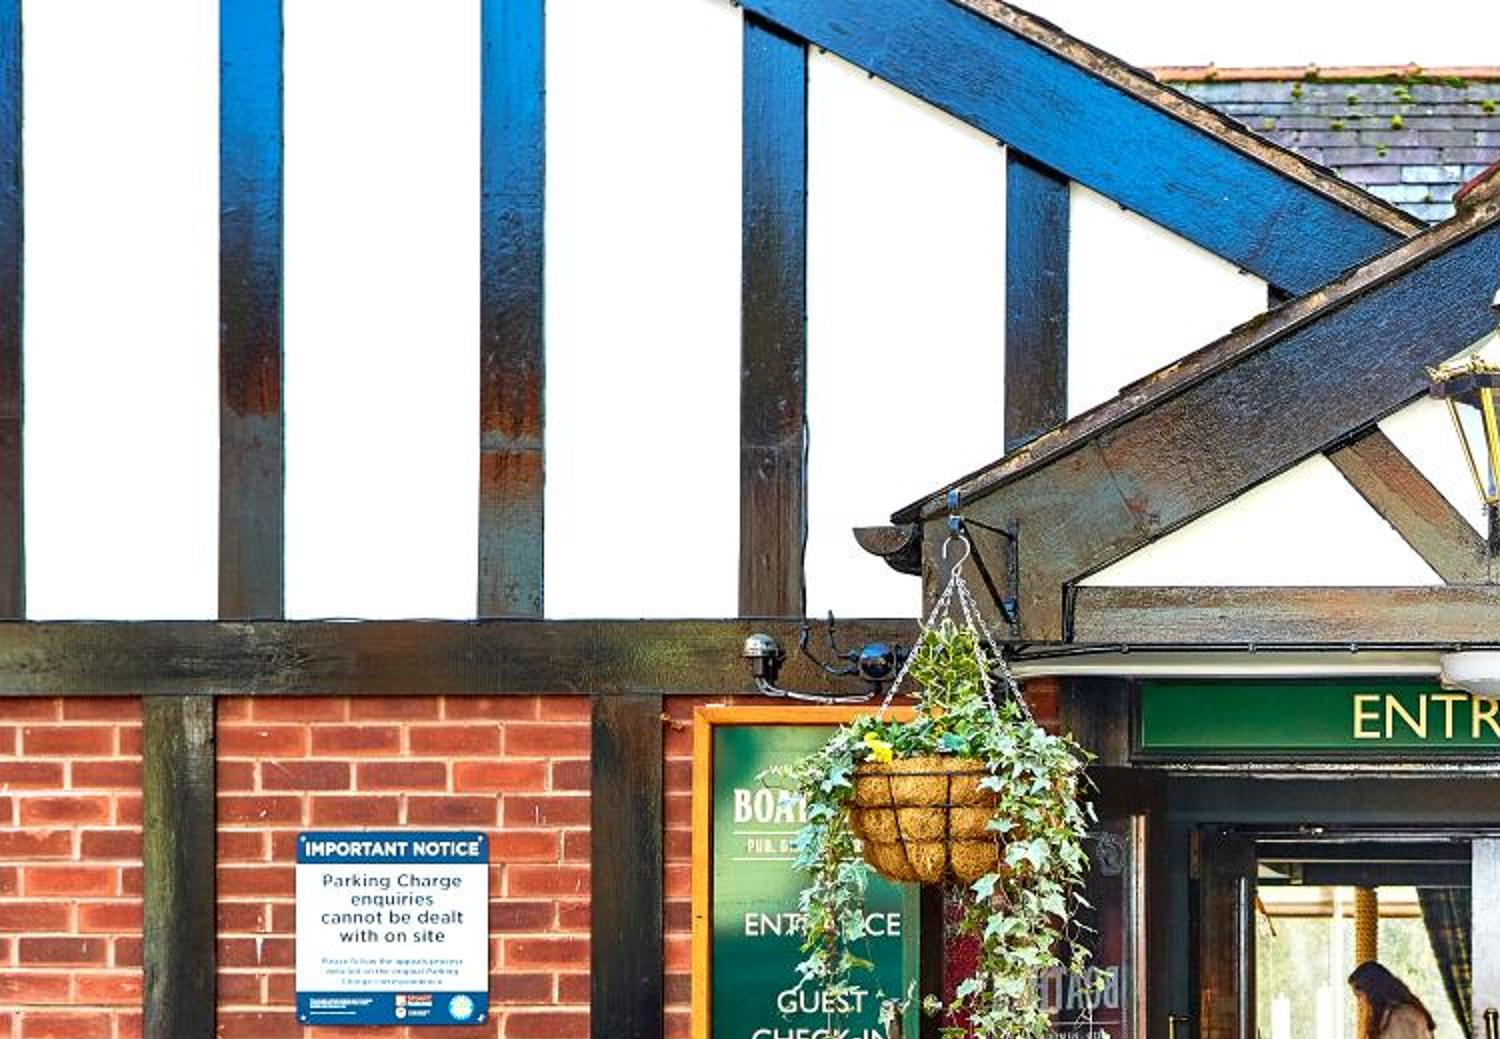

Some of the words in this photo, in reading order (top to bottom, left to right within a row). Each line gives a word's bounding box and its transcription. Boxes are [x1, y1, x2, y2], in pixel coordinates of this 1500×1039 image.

[305, 842, 408, 856] IMPORTANT
[413, 842, 480, 856] NOTICE
[323, 873, 391, 890] Parking
[397, 873, 463, 890] Charge
[351, 892, 435, 908] enquiries
[321, 912, 382, 924] cannot
[389, 911, 411, 924] be
[417, 911, 464, 924] dealt
[339, 929, 379, 943] with
[384, 932, 407, 943] on
[413, 929, 446, 943] site
[777, 990, 868, 1013] GUEST
